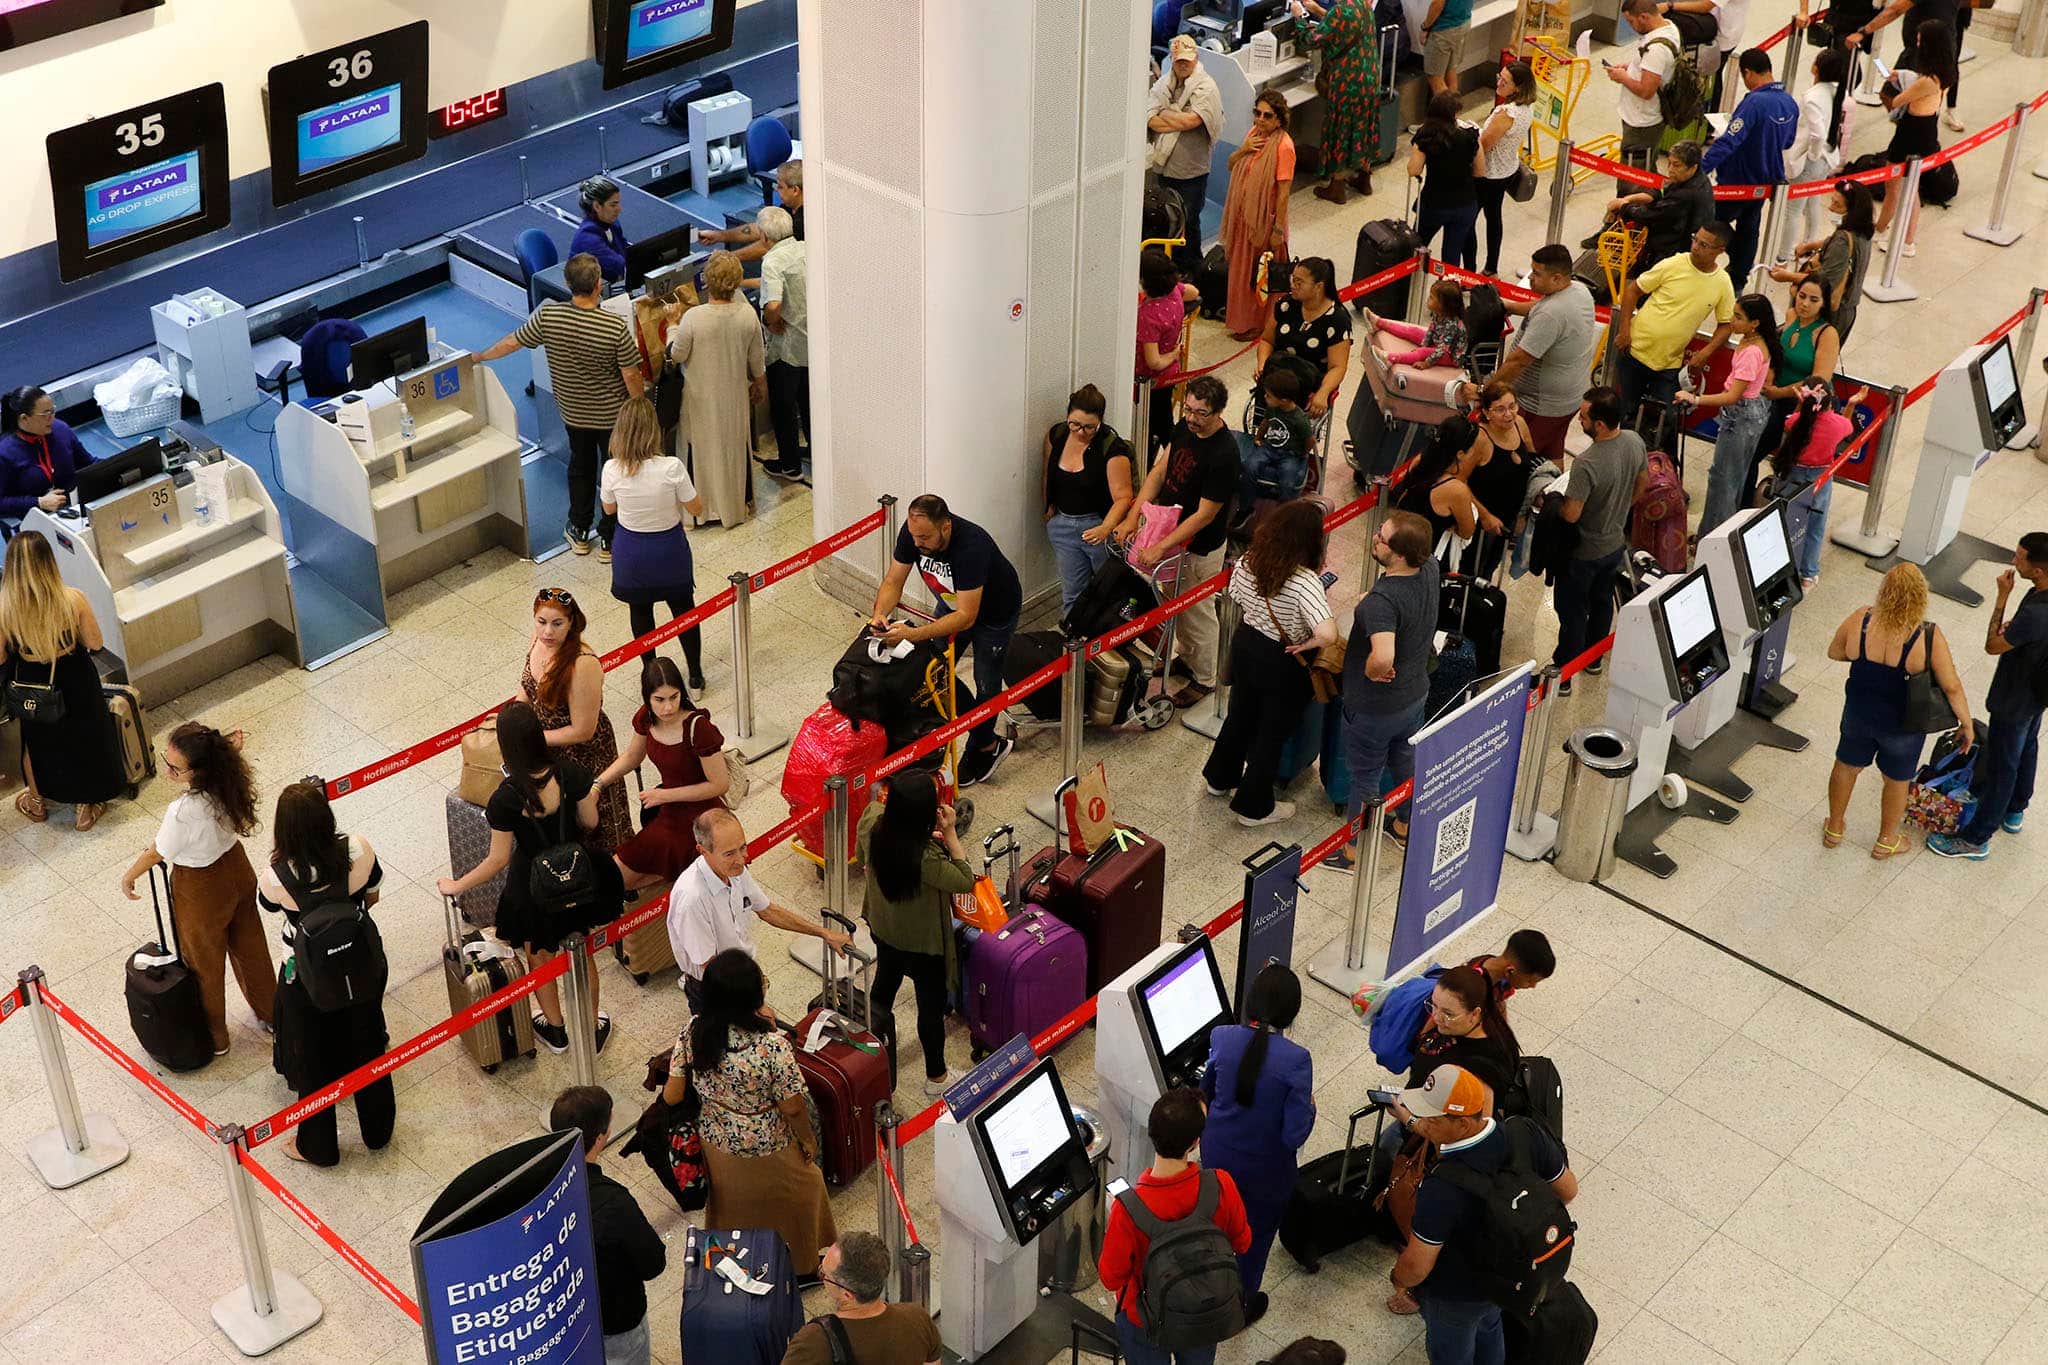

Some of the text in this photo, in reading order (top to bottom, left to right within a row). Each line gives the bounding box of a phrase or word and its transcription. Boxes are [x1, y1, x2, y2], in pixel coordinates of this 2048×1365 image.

[327, 49, 374, 88] 36
[331, 102, 382, 126] LATAM
[115, 112, 166, 156] 35
[108, 201, 142, 219] DROP
[144, 183, 198, 208] EXPRESS
[122, 172, 178, 196] LATAM
[410, 381, 426, 399] 36
[152, 488, 168, 508] 35
[828, 536, 848, 549] Venda
[642, 634, 663, 647] Venda
[678, 613, 700, 629] milhas
[1493, 682, 1524, 706] LATAM
[363, 752, 410, 782] HotMilhas
[435, 734, 460, 748] Venda
[875, 750, 914, 778] HotMilhas
[936, 728, 956, 741] Venda
[956, 719, 970, 730] suas
[970, 707, 991, 723] milhas
[768, 805, 820, 843] hotmilhas.com.br
[618, 904, 663, 934] HotMilhas
[285, 979, 537, 1124] HotMilhas Venda suas milhas hotmilhas.com.br
[1035, 1020, 1076, 1050] suas milhas
[536, 1164, 577, 1221] LATAM
[447, 1211, 577, 1306] Entrega de
[451, 1256, 570, 1335] Bagagem
[455, 1267, 584, 1364] Etiquetada
[516, 1298, 586, 1365] Baggage Drop
